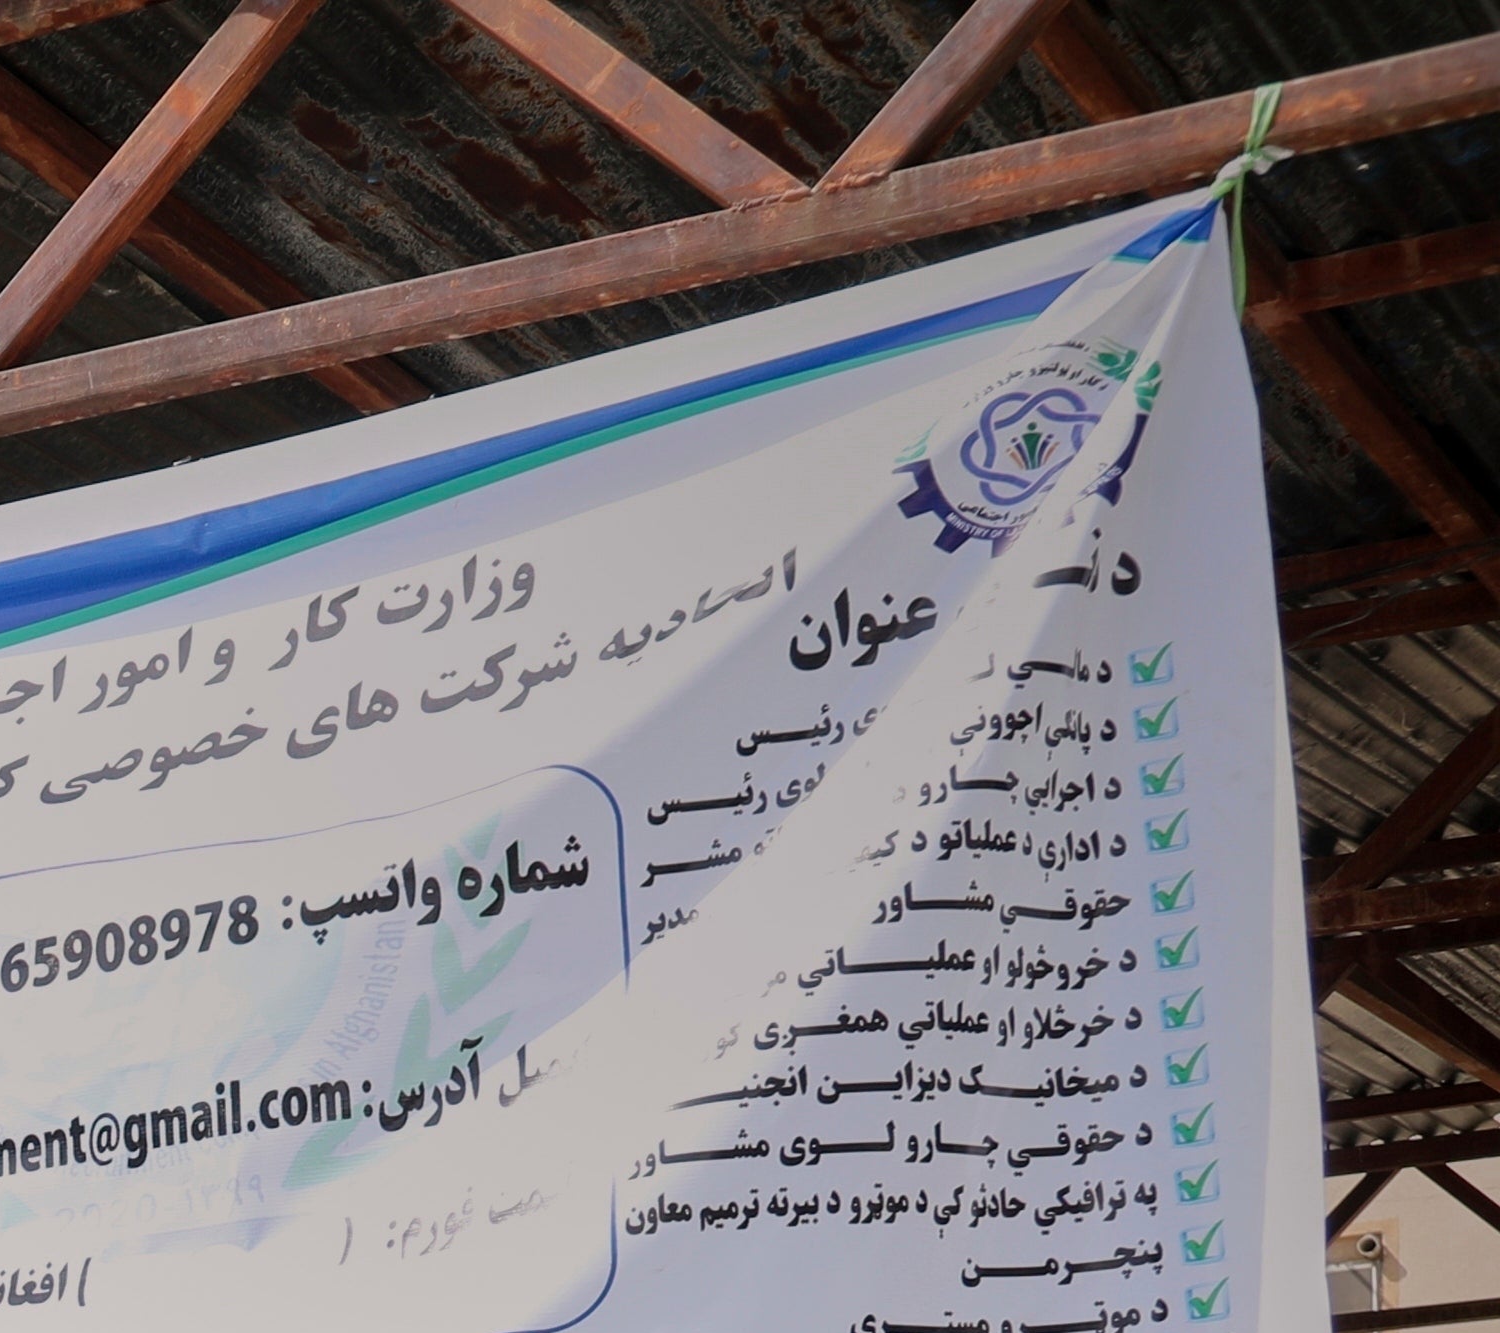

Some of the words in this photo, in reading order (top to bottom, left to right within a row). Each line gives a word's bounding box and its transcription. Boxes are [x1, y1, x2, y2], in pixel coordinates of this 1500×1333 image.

[376, 553, 536, 634] وزارت
[268, 586, 361, 671] کار
[789, 587, 939, 671] عنوان
[83, 627, 193, 716] امور
[204, 637, 236, 686] و
[420, 632, 579, 714] شرکت
[1097, 660, 1113, 683] د
[285, 681, 400, 760] های
[736, 703, 845, 757] رئیس
[1100, 718, 1117, 742] د
[39, 711, 268, 804] خصوصی
[647, 772, 768, 826] رئیس
[776, 762, 826, 808] لوی
[917, 764, 1019, 807] چارو
[1104, 777, 1122, 800] د
[911, 830, 928, 852] د
[936, 818, 1017, 861] عملیاتو
[1022, 832, 1033, 856] د
[1110, 834, 1127, 857] د
[457, 835, 591, 918] شماره
[639, 838, 743, 888] مشر
[281, 859, 442, 946] واتسپ:
[871, 879, 994, 925] مشاور
[640, 906, 699, 945] مدیر
[980, 943, 1000, 986] او
[1119, 949, 1137, 972] د
[996, 1006, 1015, 1047] او
[1124, 1006, 1143, 1030] د
[362, 1030, 483, 1133] آدرس:
[664, 1065, 807, 1112] انجنی
[817, 1060, 951, 1104] دیزاین
[959, 1063, 1120, 1107] میخانیک
[1130, 1064, 1148, 1088] د
[627, 1128, 770, 1180] مشاور
[779, 1120, 896, 1166] لوی
[904, 1121, 999, 1169] چارو
[1135, 1122, 1153, 1146] د
[625, 1192, 694, 1236] معاون
[699, 1188, 760, 1232] ترمیم
[766, 1187, 820, 1228] بیرته
[826, 1190, 841, 1214] د
[915, 1189, 928, 1214] د
[1133, 1182, 1158, 1216] په
[961, 1239, 1164, 1287] پنچرمن
[1150, 1297, 1170, 1322] د
